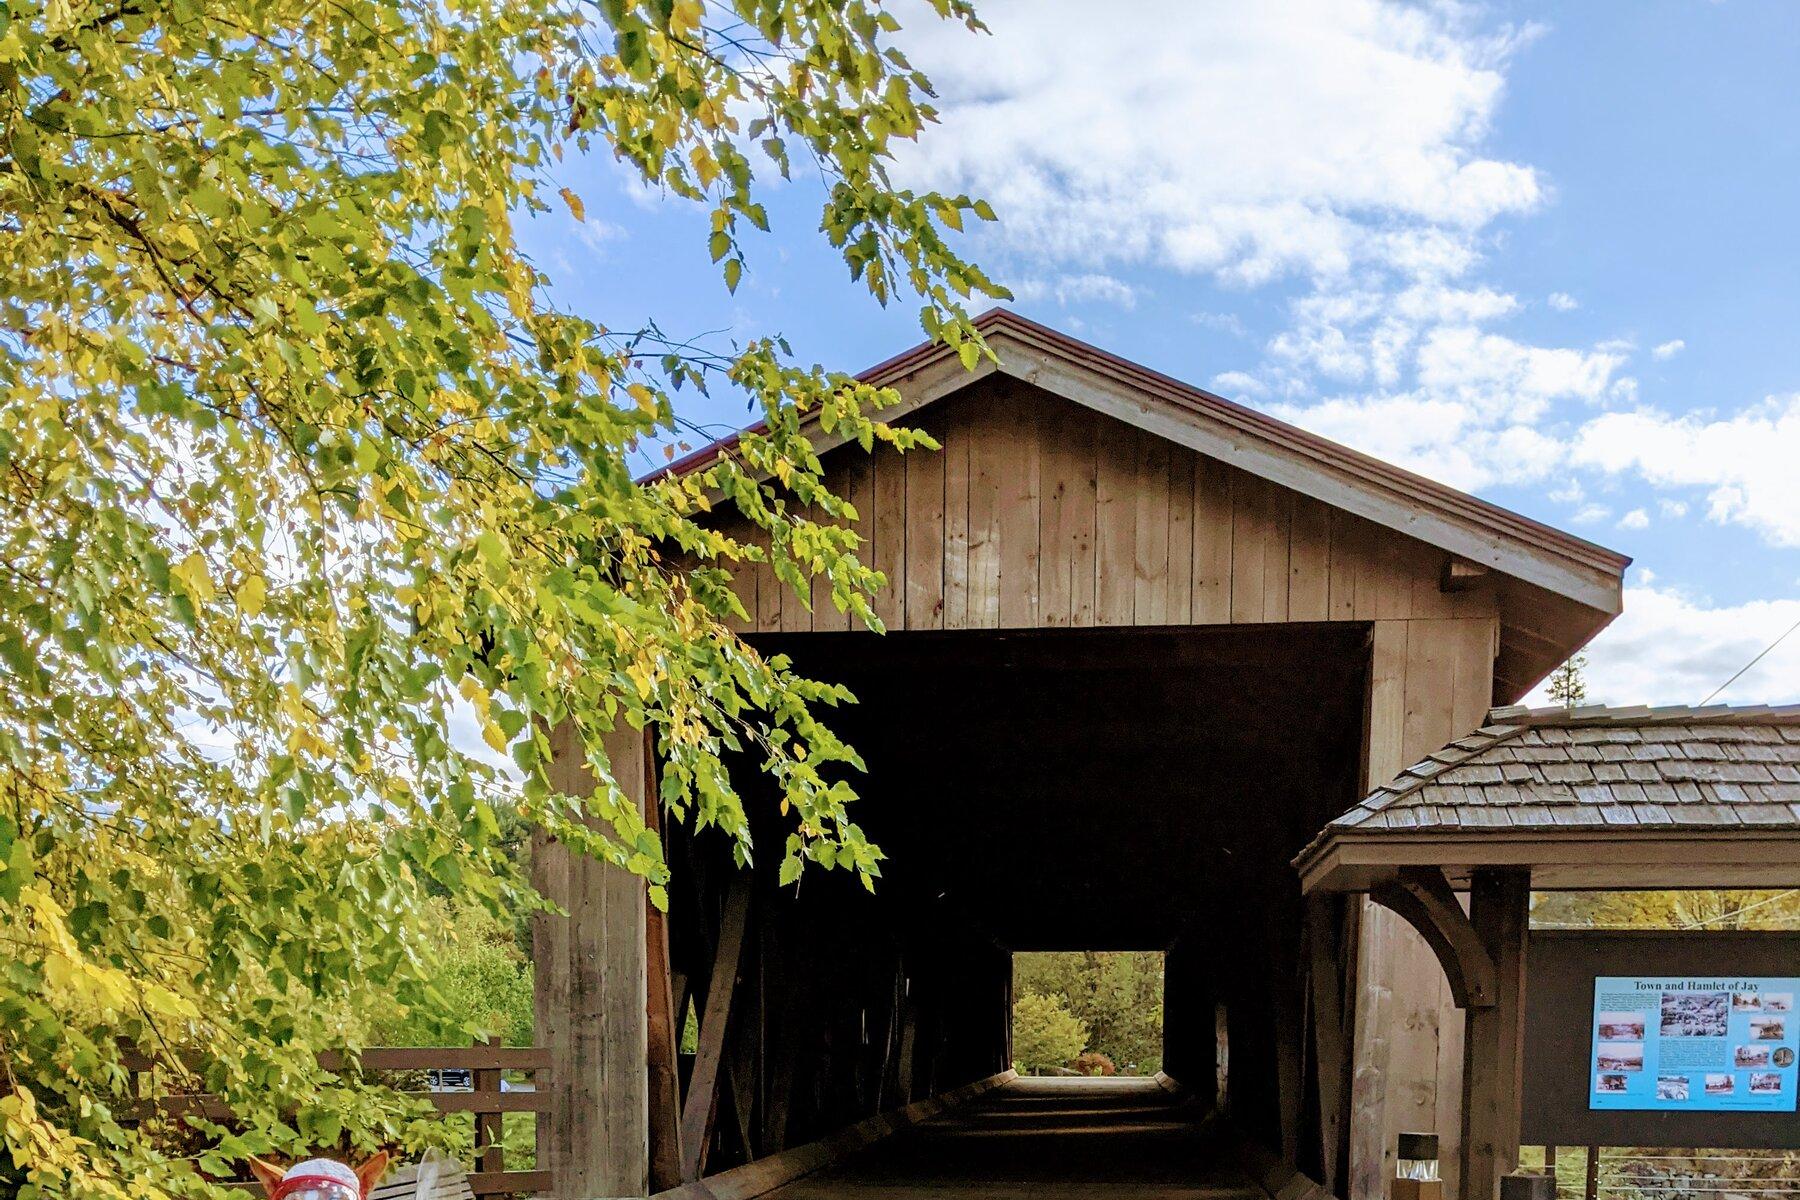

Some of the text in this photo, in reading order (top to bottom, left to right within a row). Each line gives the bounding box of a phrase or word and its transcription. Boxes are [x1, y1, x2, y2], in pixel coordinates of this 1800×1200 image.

[1634, 981, 1760, 993] Town and Hamlet of Jay
